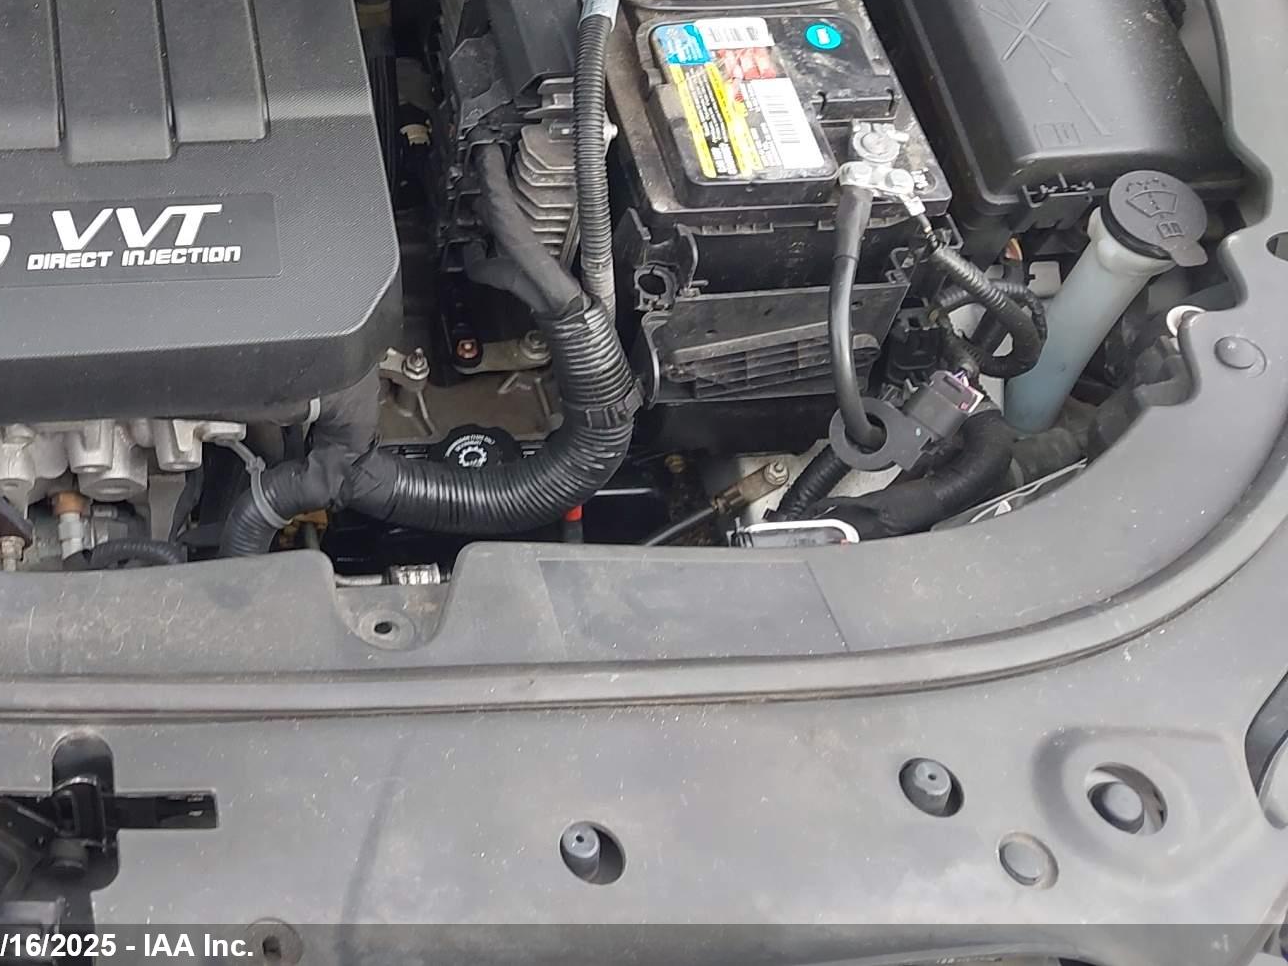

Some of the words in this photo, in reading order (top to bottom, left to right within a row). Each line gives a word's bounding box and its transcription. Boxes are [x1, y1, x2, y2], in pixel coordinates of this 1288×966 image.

[51, 203, 223, 250] VVT
[26, 250, 114, 271] DIRECT
[121, 245, 241, 267] INJECTION
